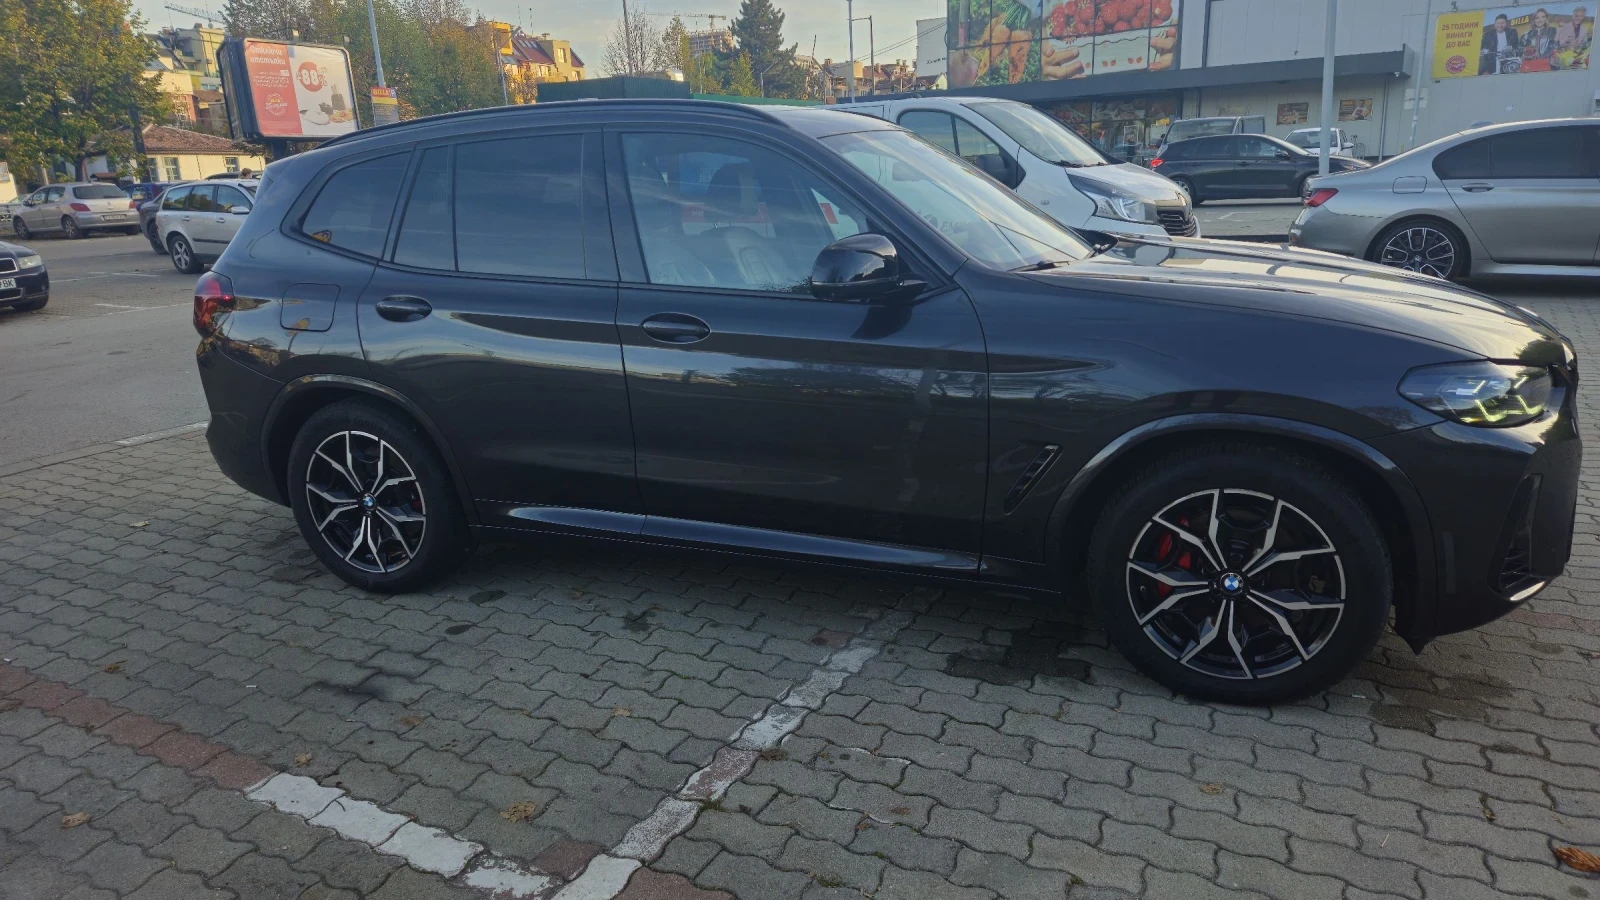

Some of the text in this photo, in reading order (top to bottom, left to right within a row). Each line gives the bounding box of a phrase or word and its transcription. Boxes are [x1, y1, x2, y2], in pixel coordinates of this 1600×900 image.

[1451, 22, 1479, 30] ГОДИНИ
[1510, 16, 1529, 26] BILLA
[1445, 40, 1471, 50] ДО ВАС
